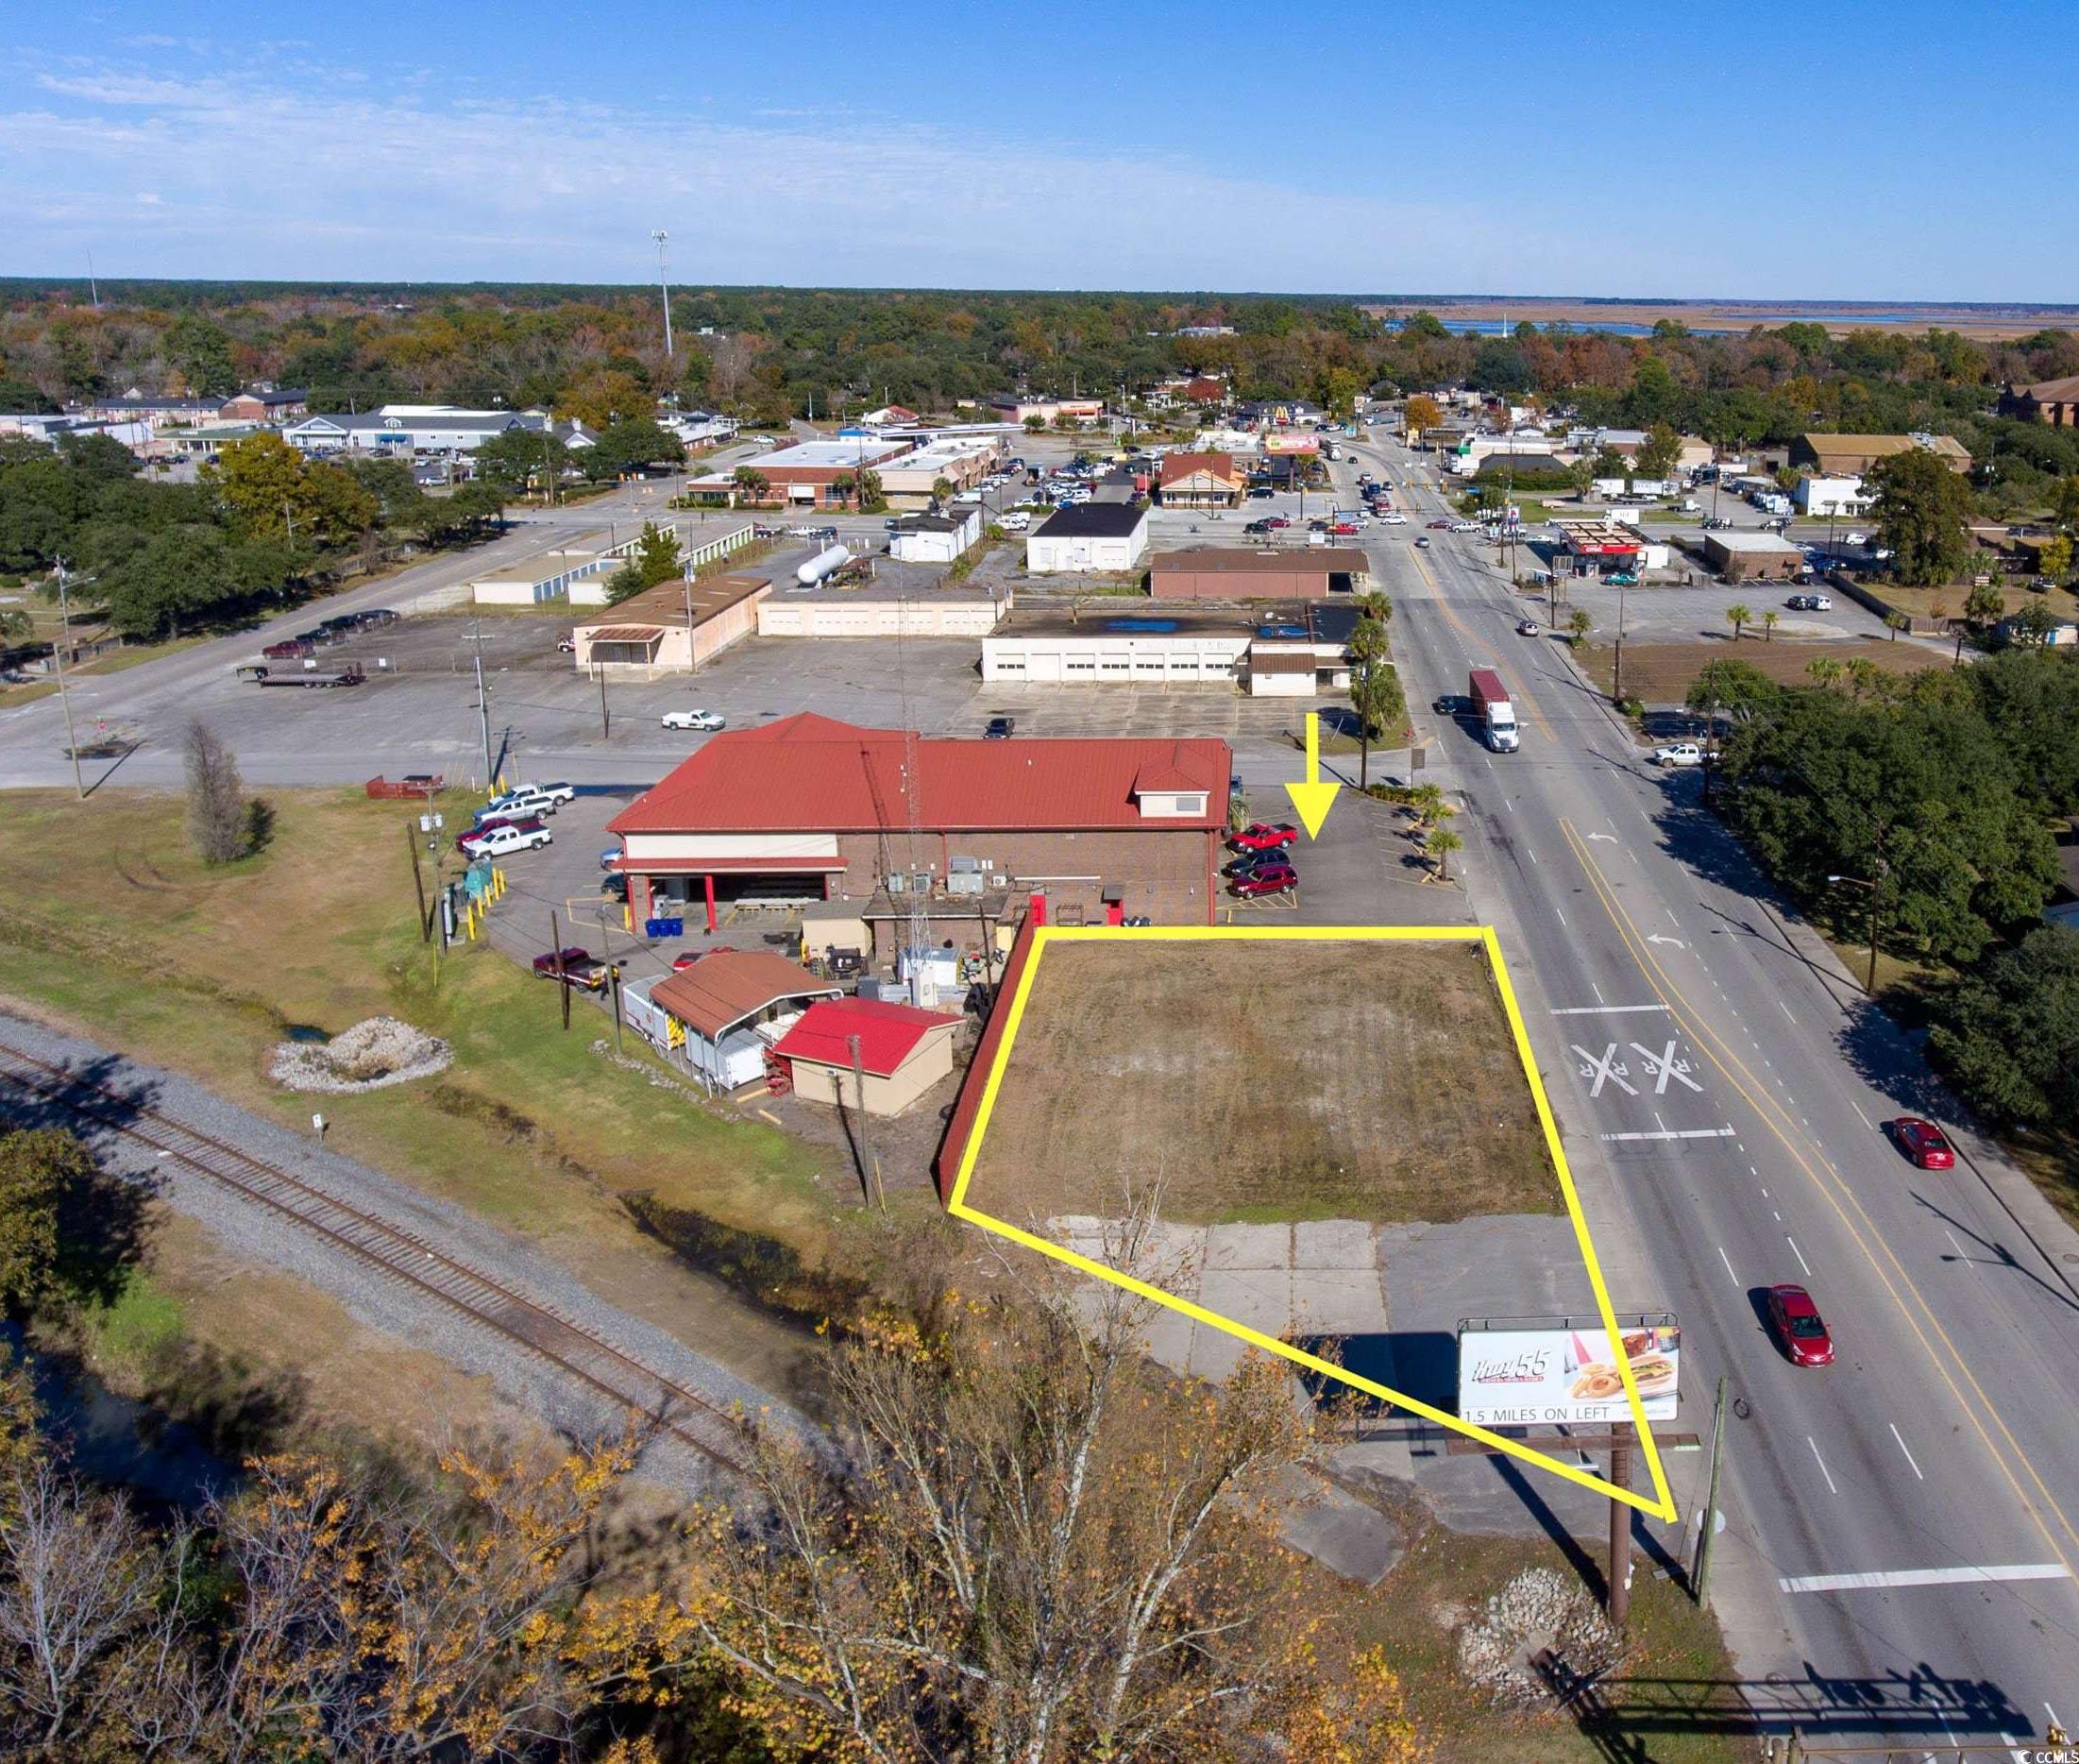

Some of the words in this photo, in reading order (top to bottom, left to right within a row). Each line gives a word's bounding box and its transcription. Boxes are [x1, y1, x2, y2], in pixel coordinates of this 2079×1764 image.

[1464, 1410, 1485, 1423] 1.5
[1493, 1408, 1537, 1421] MILES
[1544, 1408, 1567, 1420] ON
[1576, 1406, 1610, 1420] LEFT
